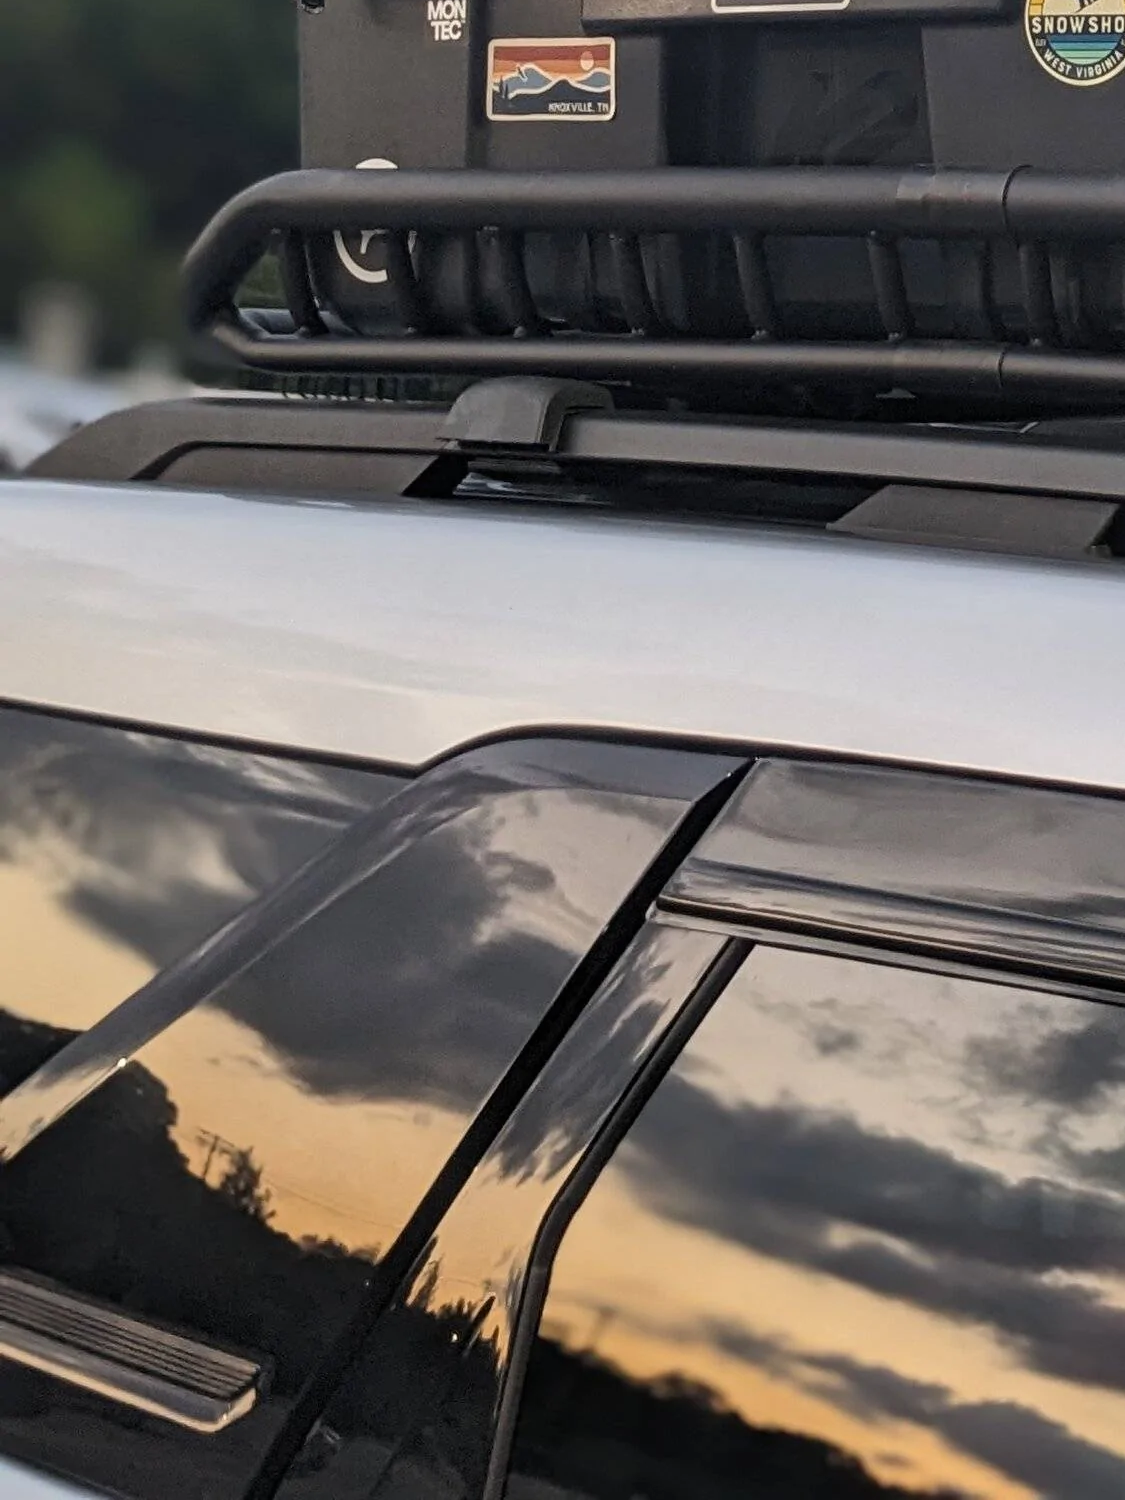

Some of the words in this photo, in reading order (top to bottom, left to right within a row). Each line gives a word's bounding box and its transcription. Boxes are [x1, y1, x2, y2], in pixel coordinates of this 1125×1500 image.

[427, 0, 466, 20] MON
[430, 20, 463, 40] TEC
[1043, 49, 1072, 76] WEST
[1076, 50, 1124, 78] VIRGINIA
